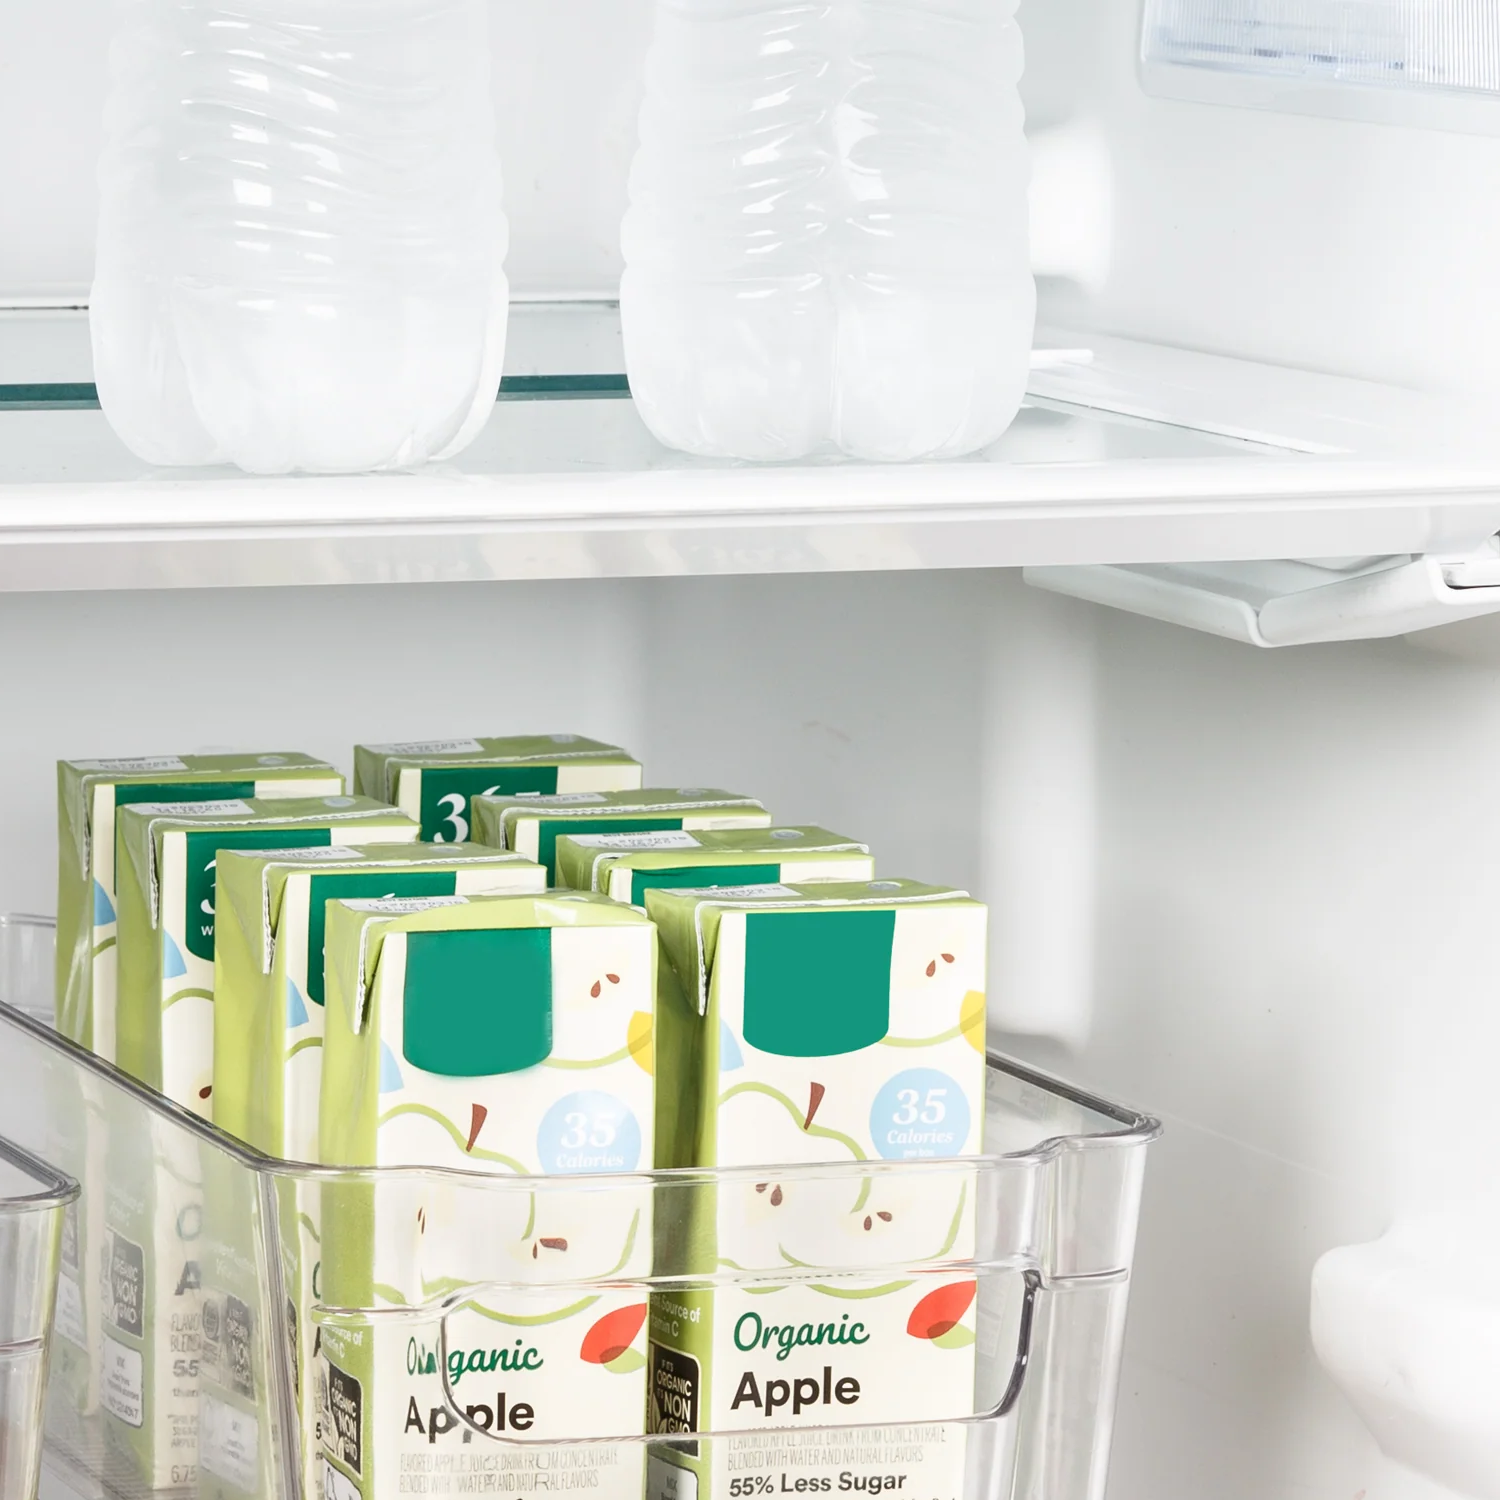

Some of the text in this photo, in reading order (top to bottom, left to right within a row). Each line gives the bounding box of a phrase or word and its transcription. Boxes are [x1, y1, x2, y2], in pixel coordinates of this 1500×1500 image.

[892, 1088, 947, 1125] 35
[560, 1112, 616, 1148] 35
[887, 1128, 954, 1145] Calories
[556, 1152, 624, 1168] Calories
[690, 1308, 700, 1323] of
[672, 1321, 679, 1337] C
[733, 1312, 870, 1361] Organic
[173, 1360, 199, 1377] 55
[656, 1370, 692, 1396] ORGANIC
[730, 1366, 861, 1417] Apple
[664, 1391, 691, 1422] NON
[728, 1446, 924, 1471] BLENDED WITH WATER AND NATURAL FLAVORS
[729, 1471, 907, 1497] 55% Less Sugar
